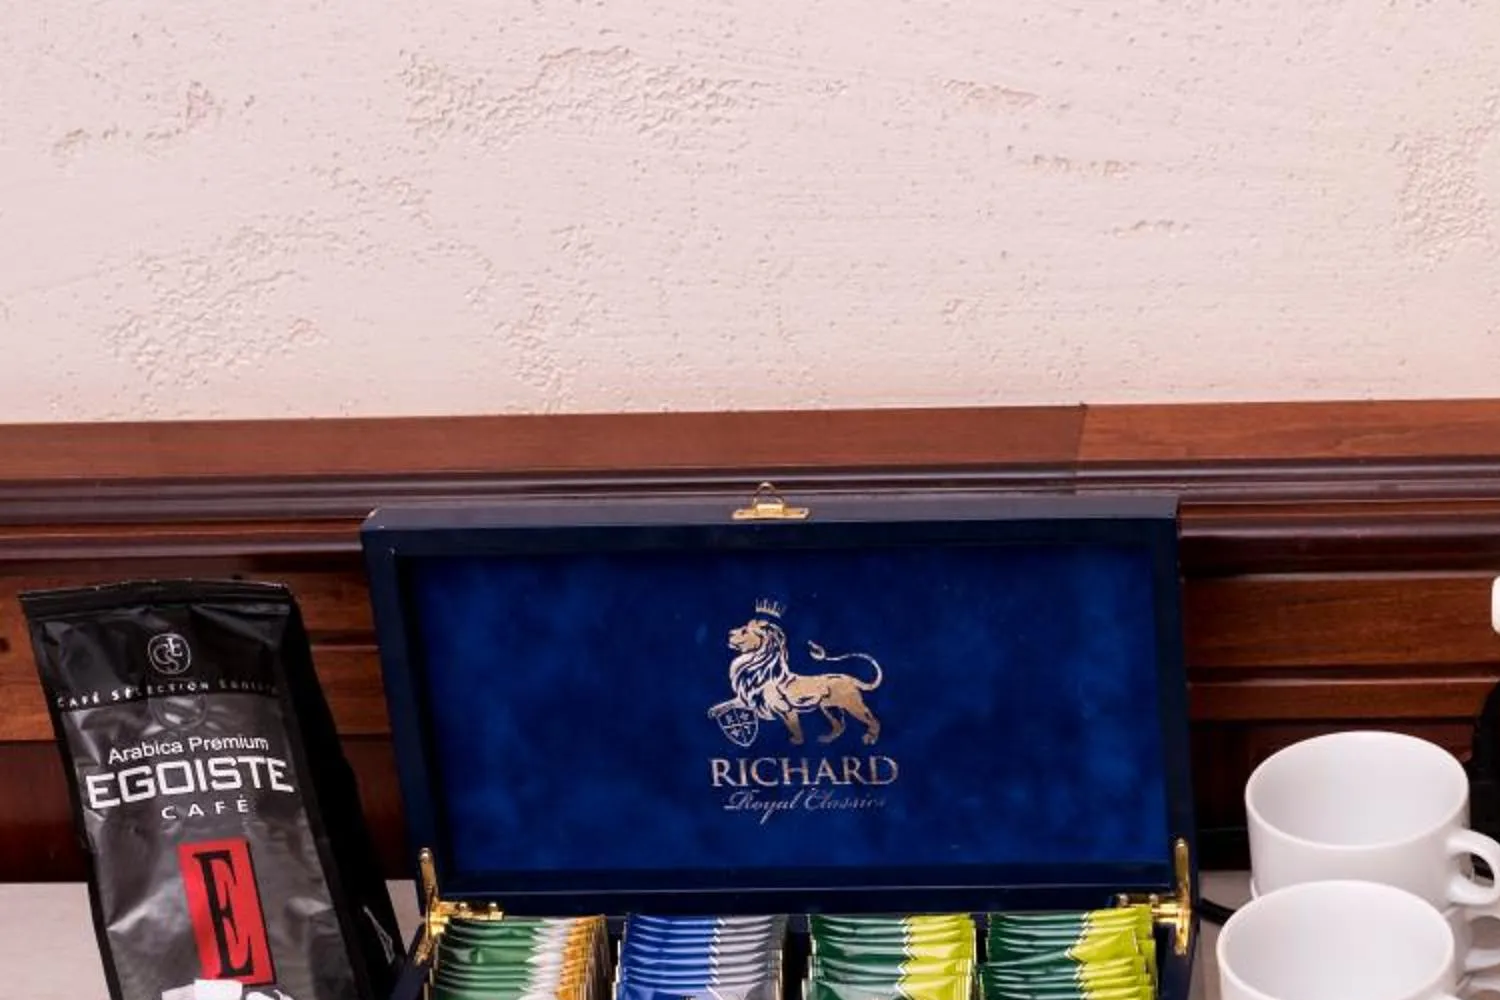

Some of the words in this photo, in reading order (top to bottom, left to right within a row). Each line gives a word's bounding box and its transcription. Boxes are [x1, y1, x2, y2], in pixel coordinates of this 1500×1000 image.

[107, 739, 184, 766] Arabica
[188, 735, 270, 752] Premium
[85, 754, 296, 810] EGOISTE
[710, 755, 899, 788] RICHARD
[723, 788, 804, 825] Royal
[193, 848, 256, 979] E
